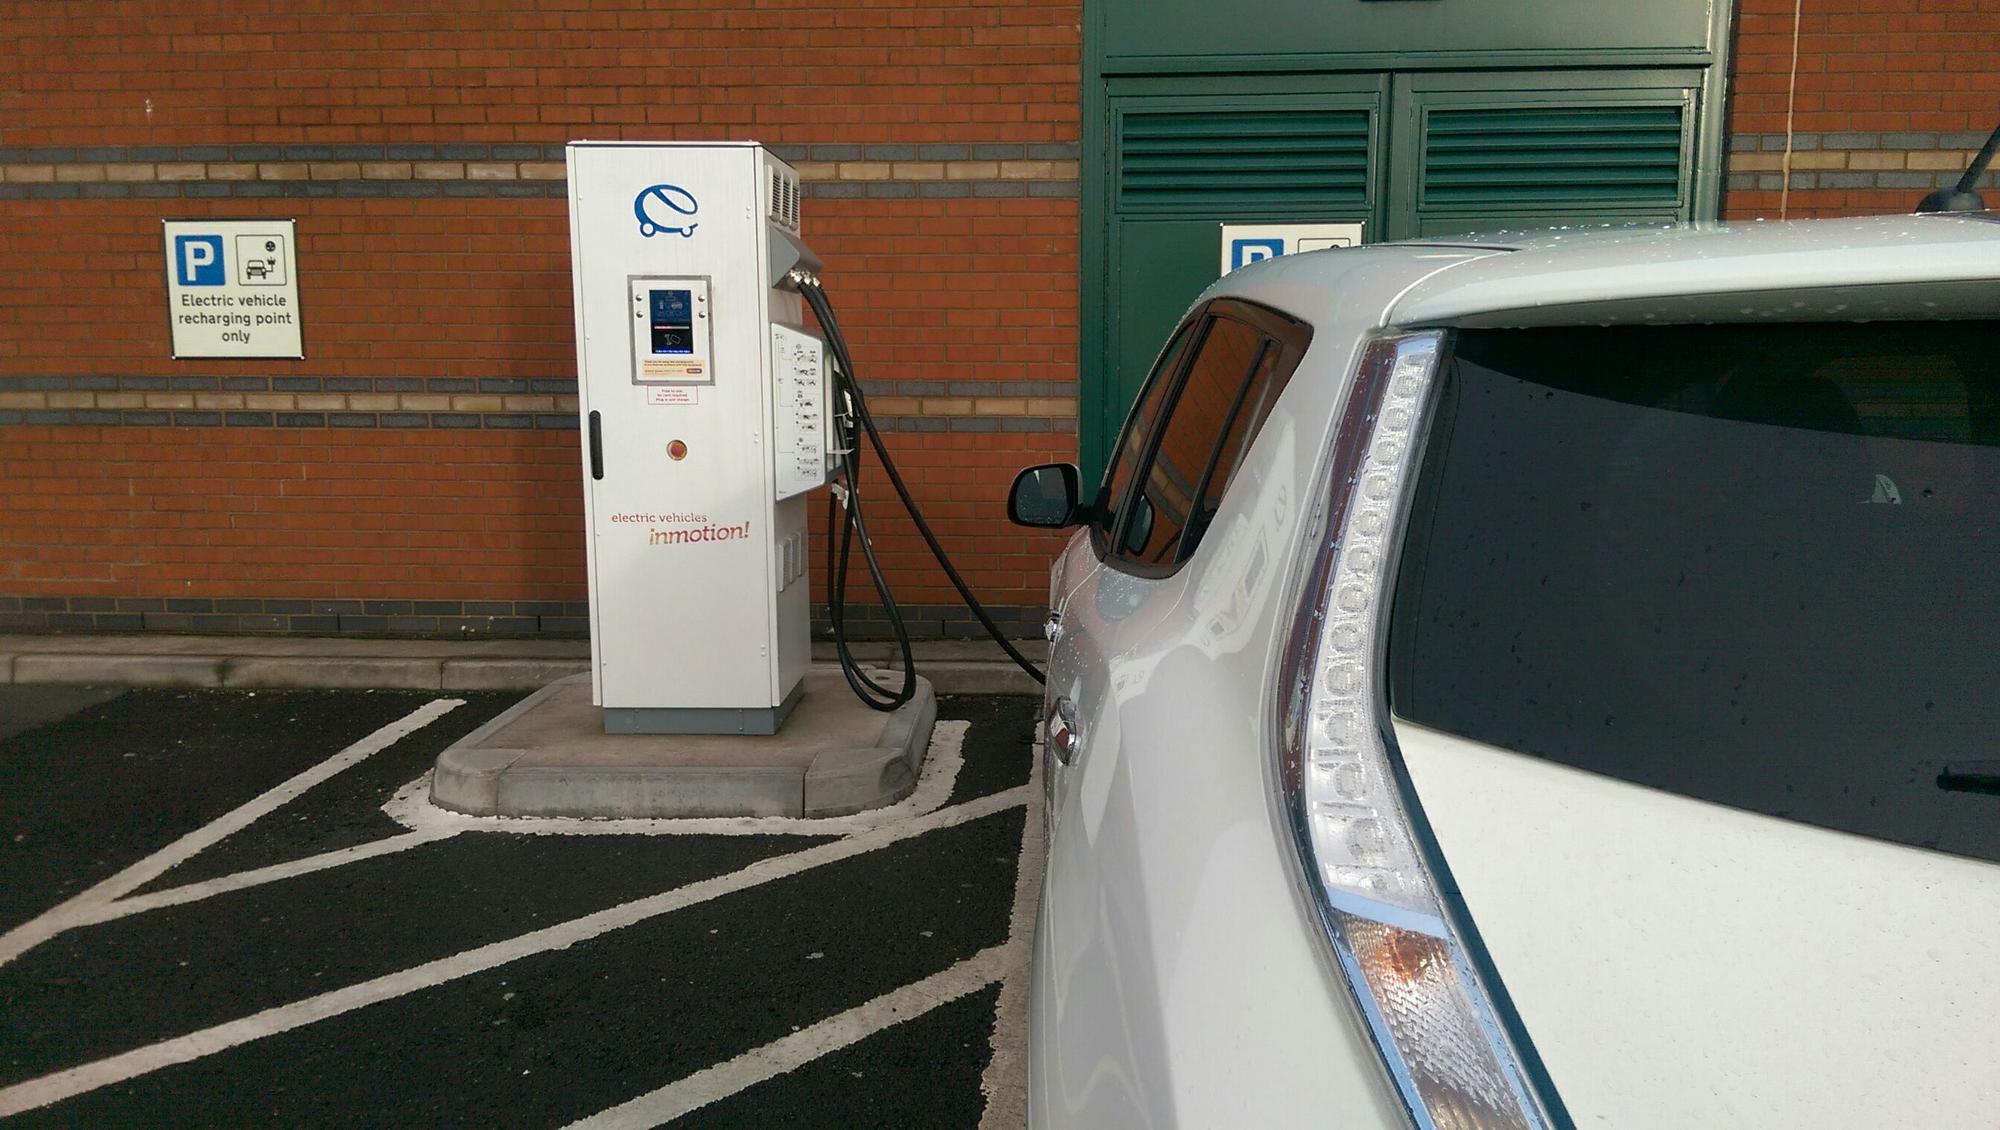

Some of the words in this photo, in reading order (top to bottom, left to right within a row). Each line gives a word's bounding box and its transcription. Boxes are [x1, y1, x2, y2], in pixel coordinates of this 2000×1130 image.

[184, 240, 215, 282] P
[181, 294, 235, 307] Electric
[238, 294, 287, 307] vehicle
[178, 312, 251, 326] recharging
[255, 312, 292, 326] point
[221, 330, 250, 344] only
[611, 512, 656, 523] electric
[658, 512, 708, 523] vehicles
[649, 521, 750, 545] inmotion!
